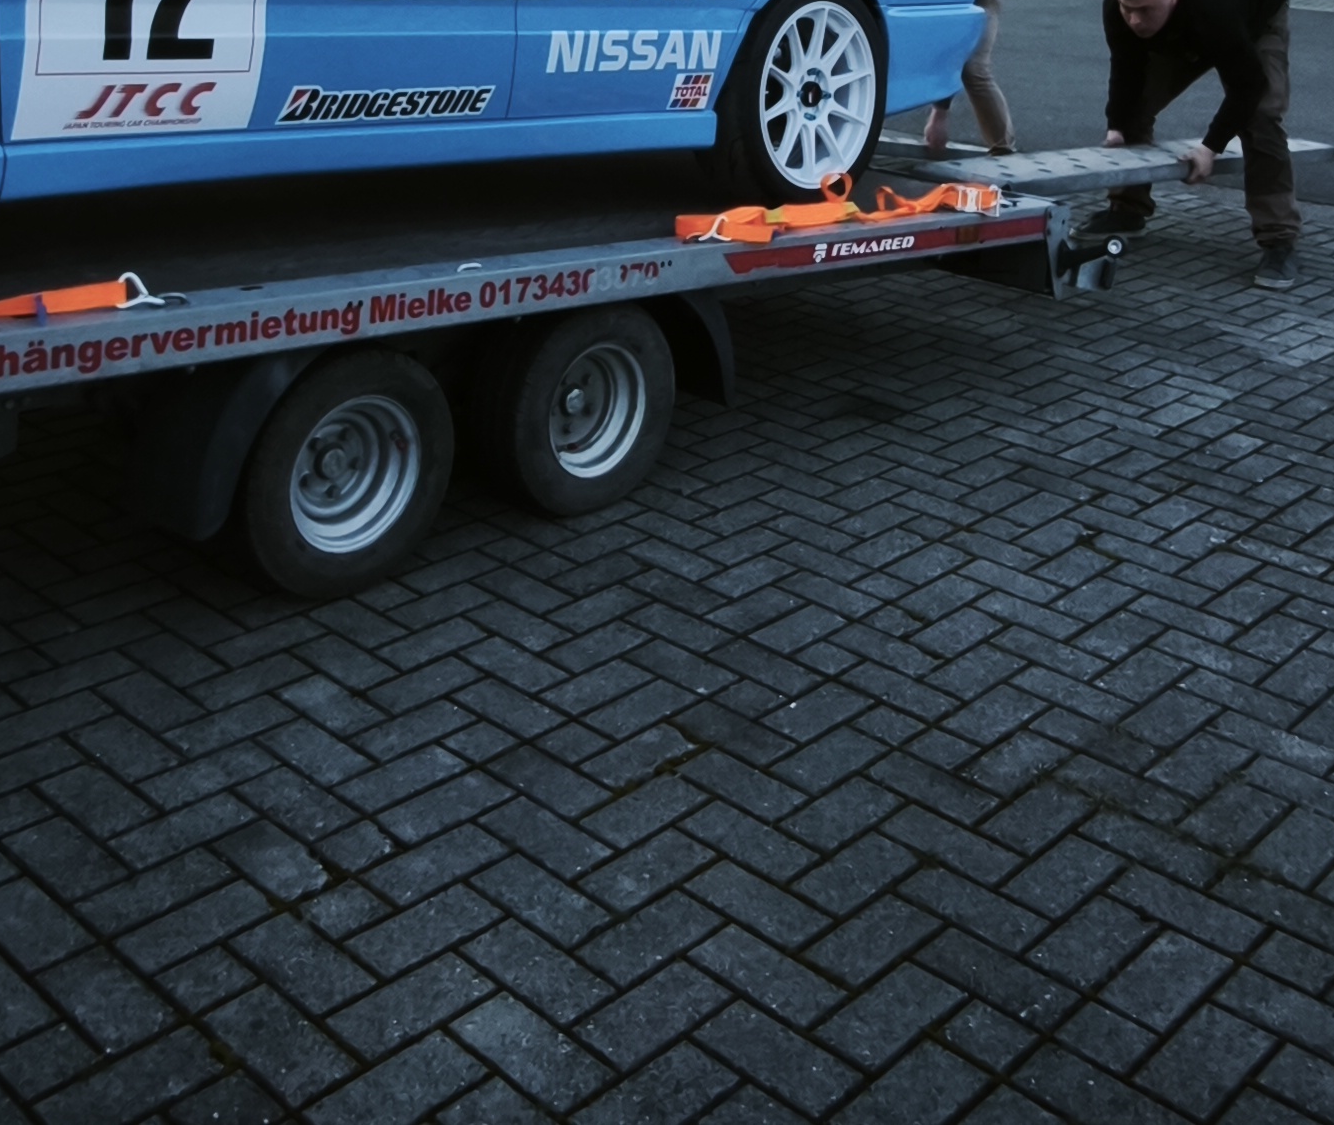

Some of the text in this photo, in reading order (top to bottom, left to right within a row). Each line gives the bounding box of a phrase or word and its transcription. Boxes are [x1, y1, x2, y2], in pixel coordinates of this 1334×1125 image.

[546, 30, 722, 73] NISSAN
[74, 81, 217, 120] JTCC
[277, 83, 493, 122] BRIDGESTONE
[674, 85, 708, 98] TOTAL
[831, 236, 915, 257] TEMARED
[369, 288, 472, 324] Mielke
